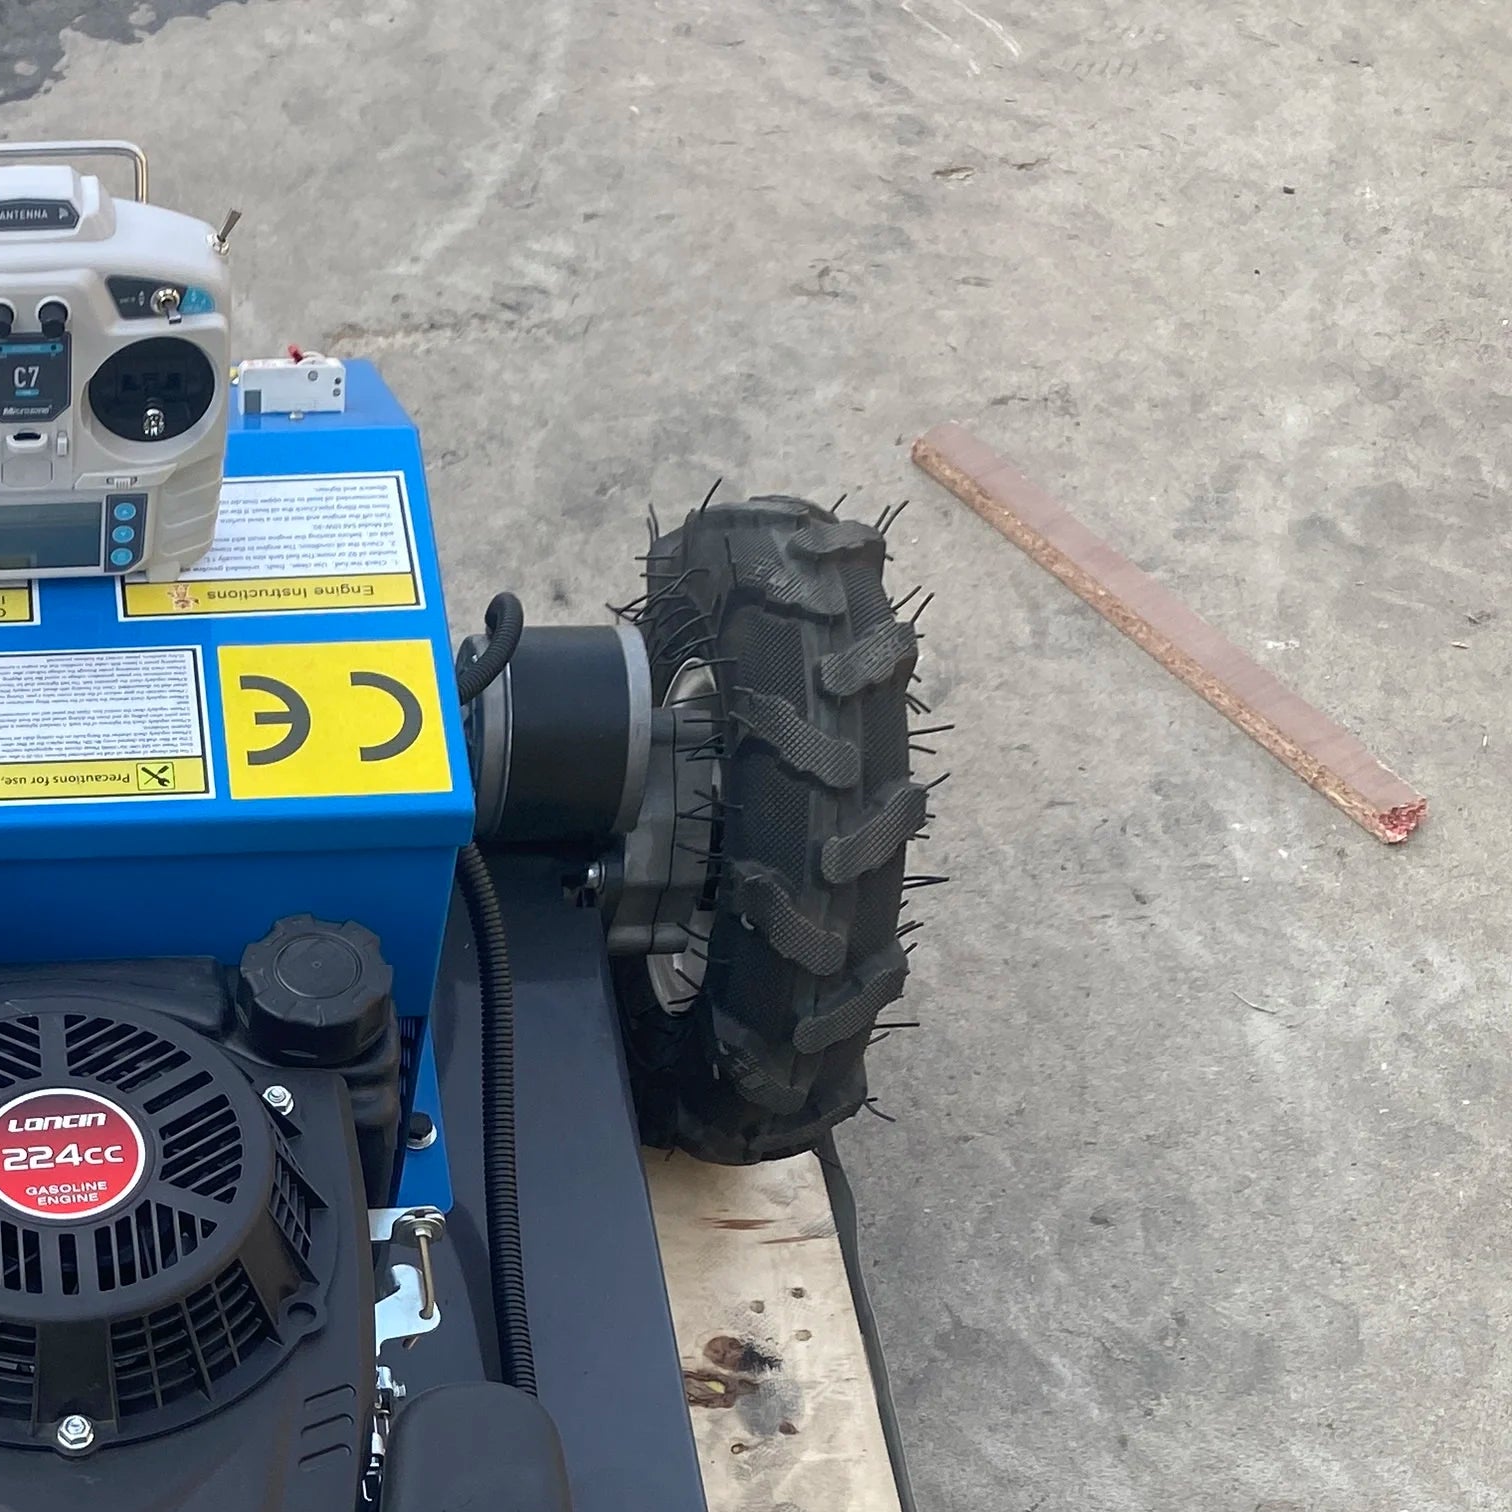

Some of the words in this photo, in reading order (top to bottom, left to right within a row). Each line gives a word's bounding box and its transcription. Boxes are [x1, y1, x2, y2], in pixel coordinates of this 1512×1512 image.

[0, 208, 48, 220] ANTENNA
[13, 365, 40, 388] C7
[208, 589, 306, 599] Instructions
[315, 584, 373, 595] Engine
[239, 671, 422, 766] CE
[32, 777, 49, 785] for
[53, 774, 129, 783] Precautions
[25, 1180, 108, 1196] GASOLINE
[37, 1192, 99, 1206] ENGINE
